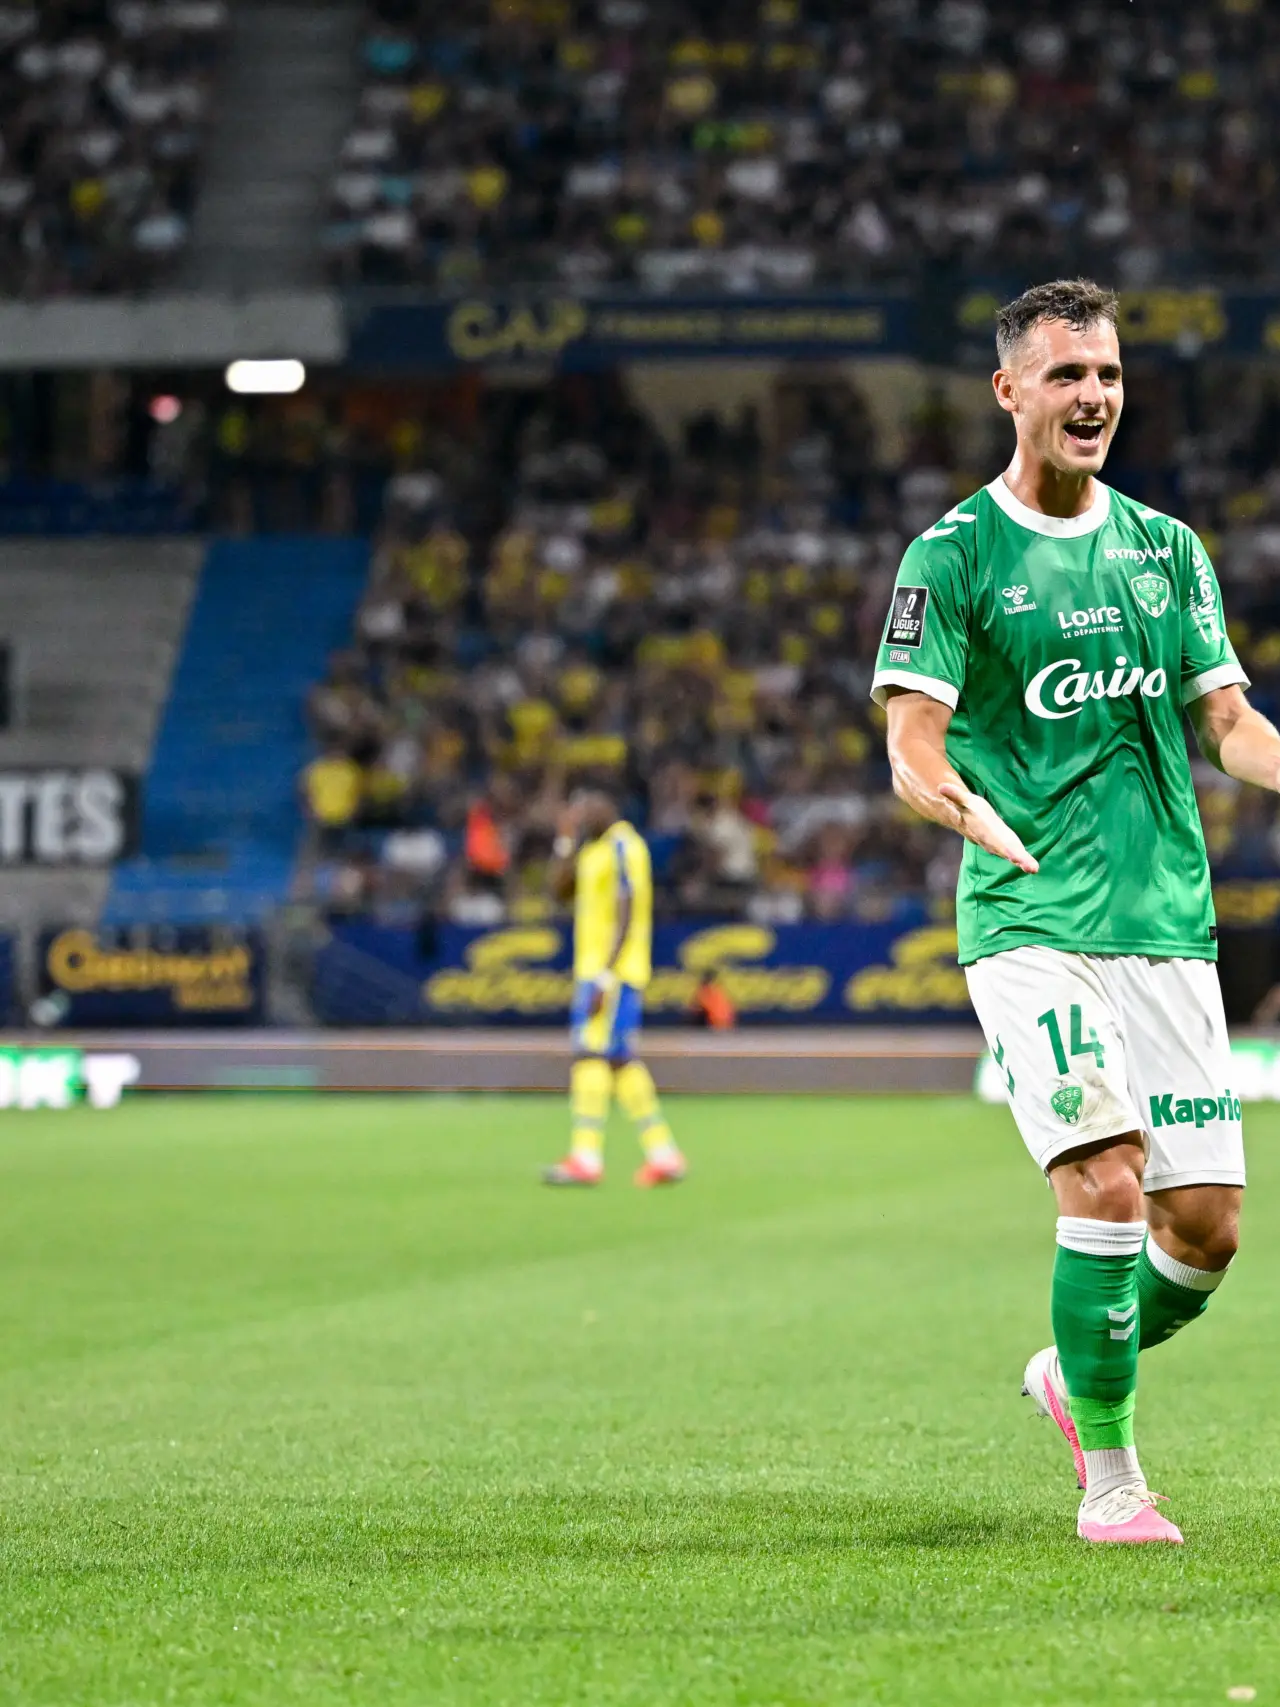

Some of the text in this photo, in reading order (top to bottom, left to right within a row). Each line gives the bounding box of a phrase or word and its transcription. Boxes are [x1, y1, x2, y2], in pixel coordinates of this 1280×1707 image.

[1004, 601, 1037, 615] hummel
[892, 618, 914, 630] LIGUE
[1058, 606, 1122, 629] Loire
[1074, 626, 1124, 637] DÉPARTEMENT
[1025, 656, 1167, 719] Casino
[1037, 1004, 1105, 1075] 14
[1053, 1090, 1080, 1105] ASSE
